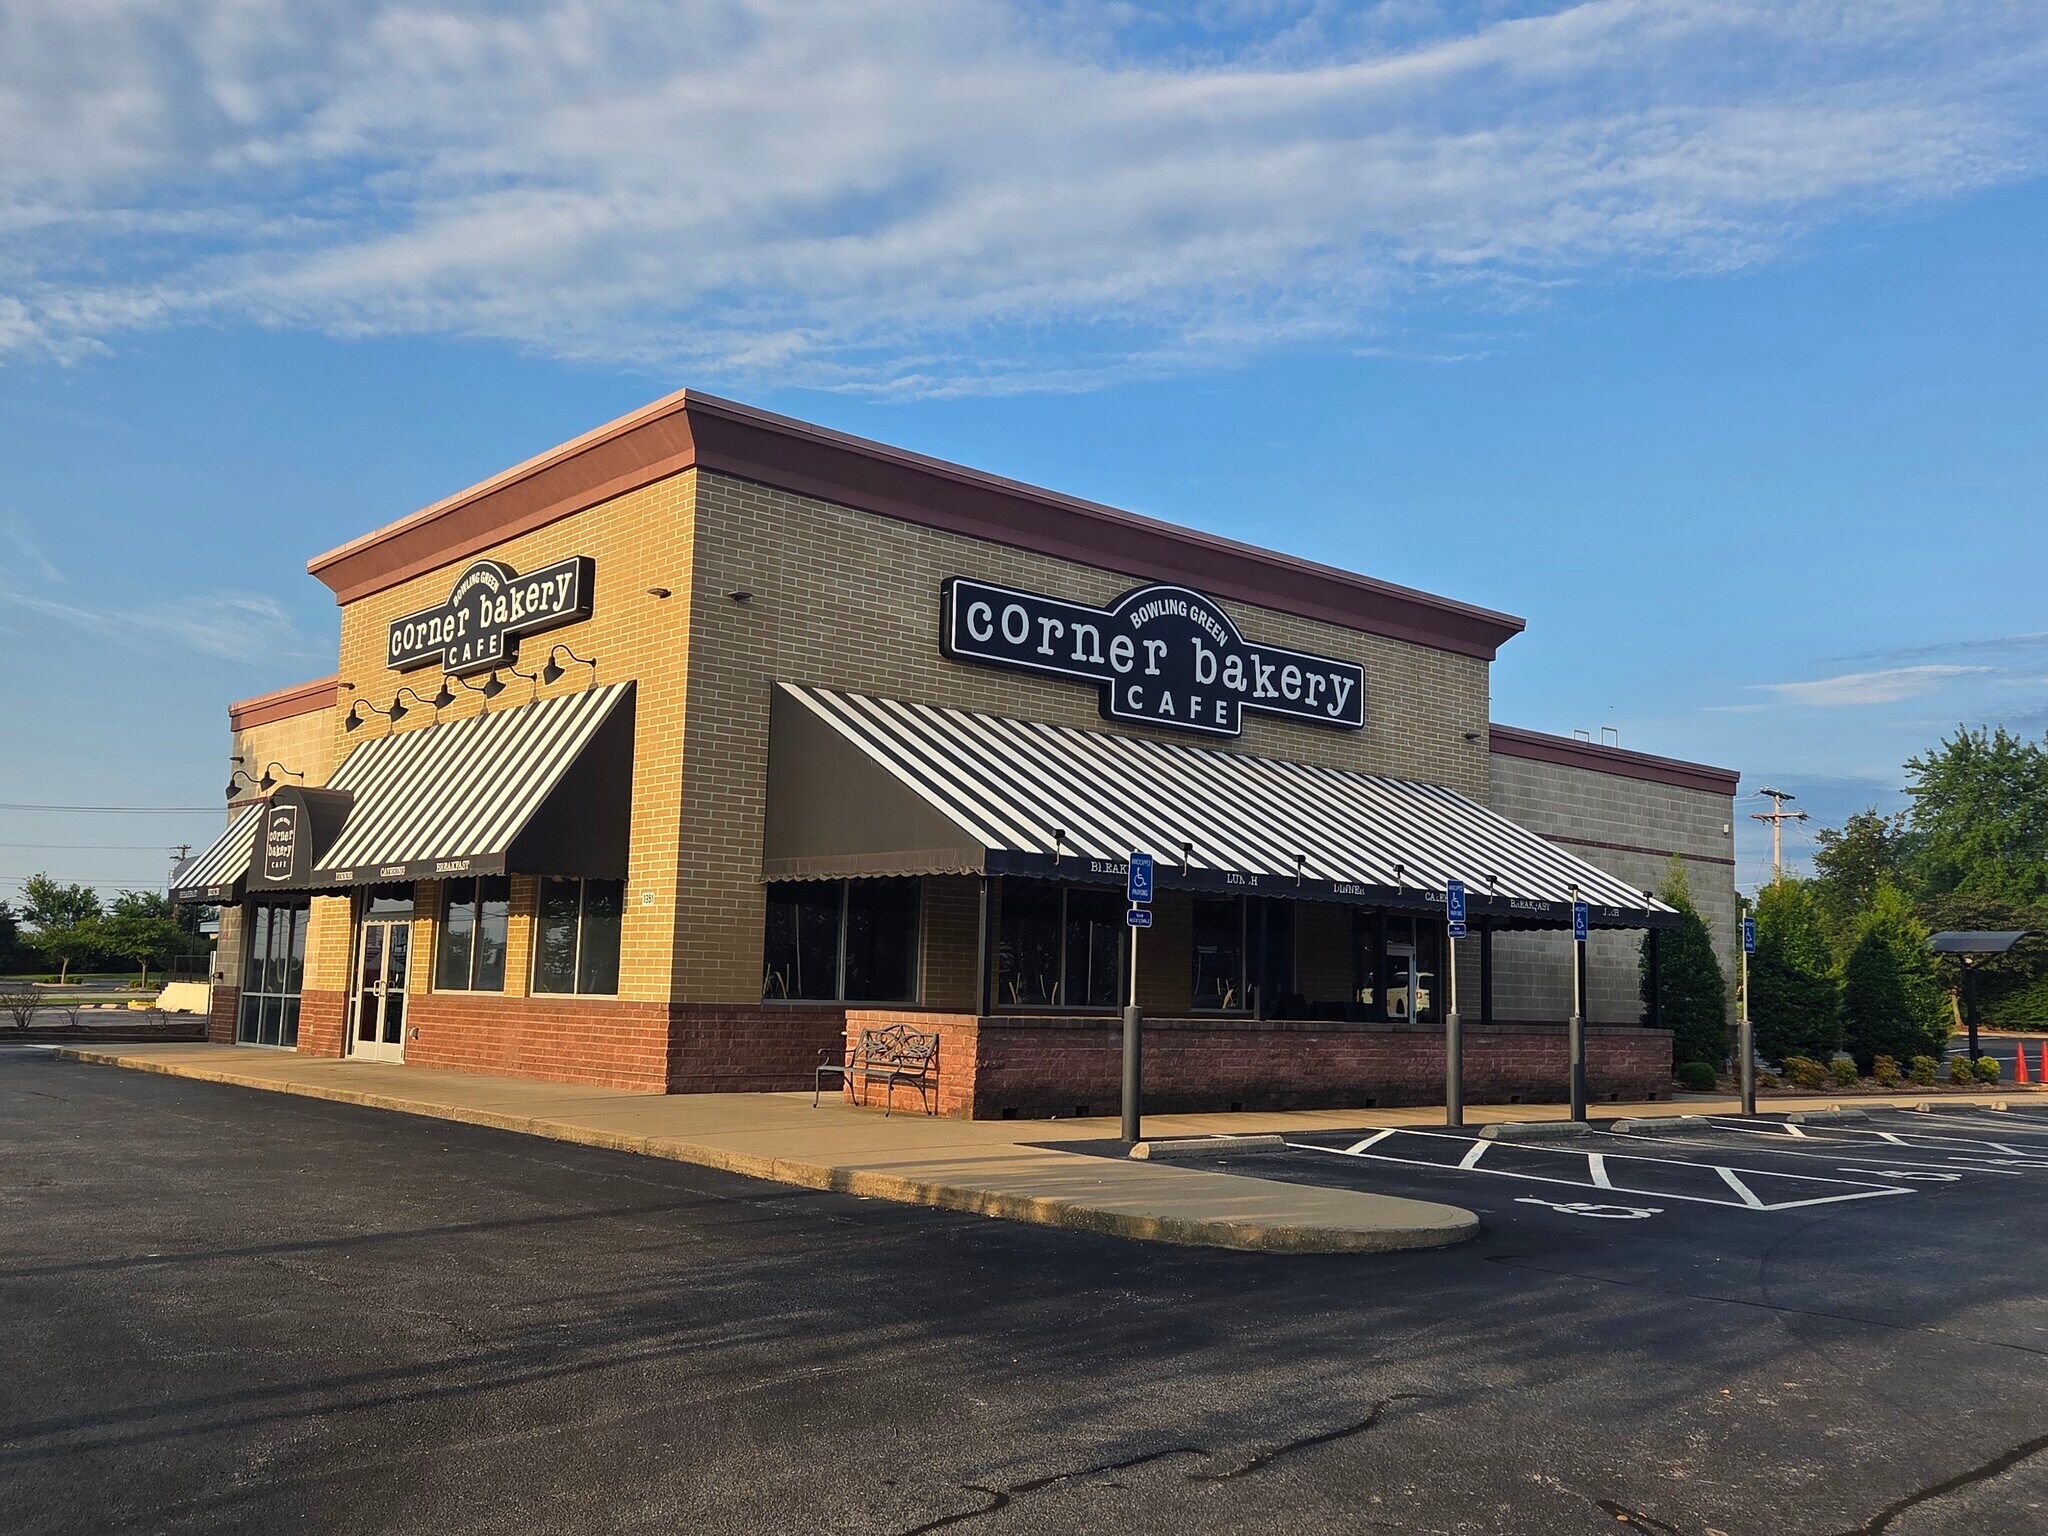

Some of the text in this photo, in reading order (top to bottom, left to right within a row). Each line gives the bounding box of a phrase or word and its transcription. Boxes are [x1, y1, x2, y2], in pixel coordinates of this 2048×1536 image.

[452, 571, 500, 607] BOWLING GREEN
[391, 571, 573, 656] corner bakery
[1129, 598, 1227, 648] BOWLING GREEN
[449, 634, 497, 665] CAFE
[966, 601, 1354, 717] corner bakery
[1127, 685, 1227, 725] CAFE
[268, 844, 292, 857] bakery
[269, 829, 294, 842] corner
[271, 860, 287, 868] CAFE
